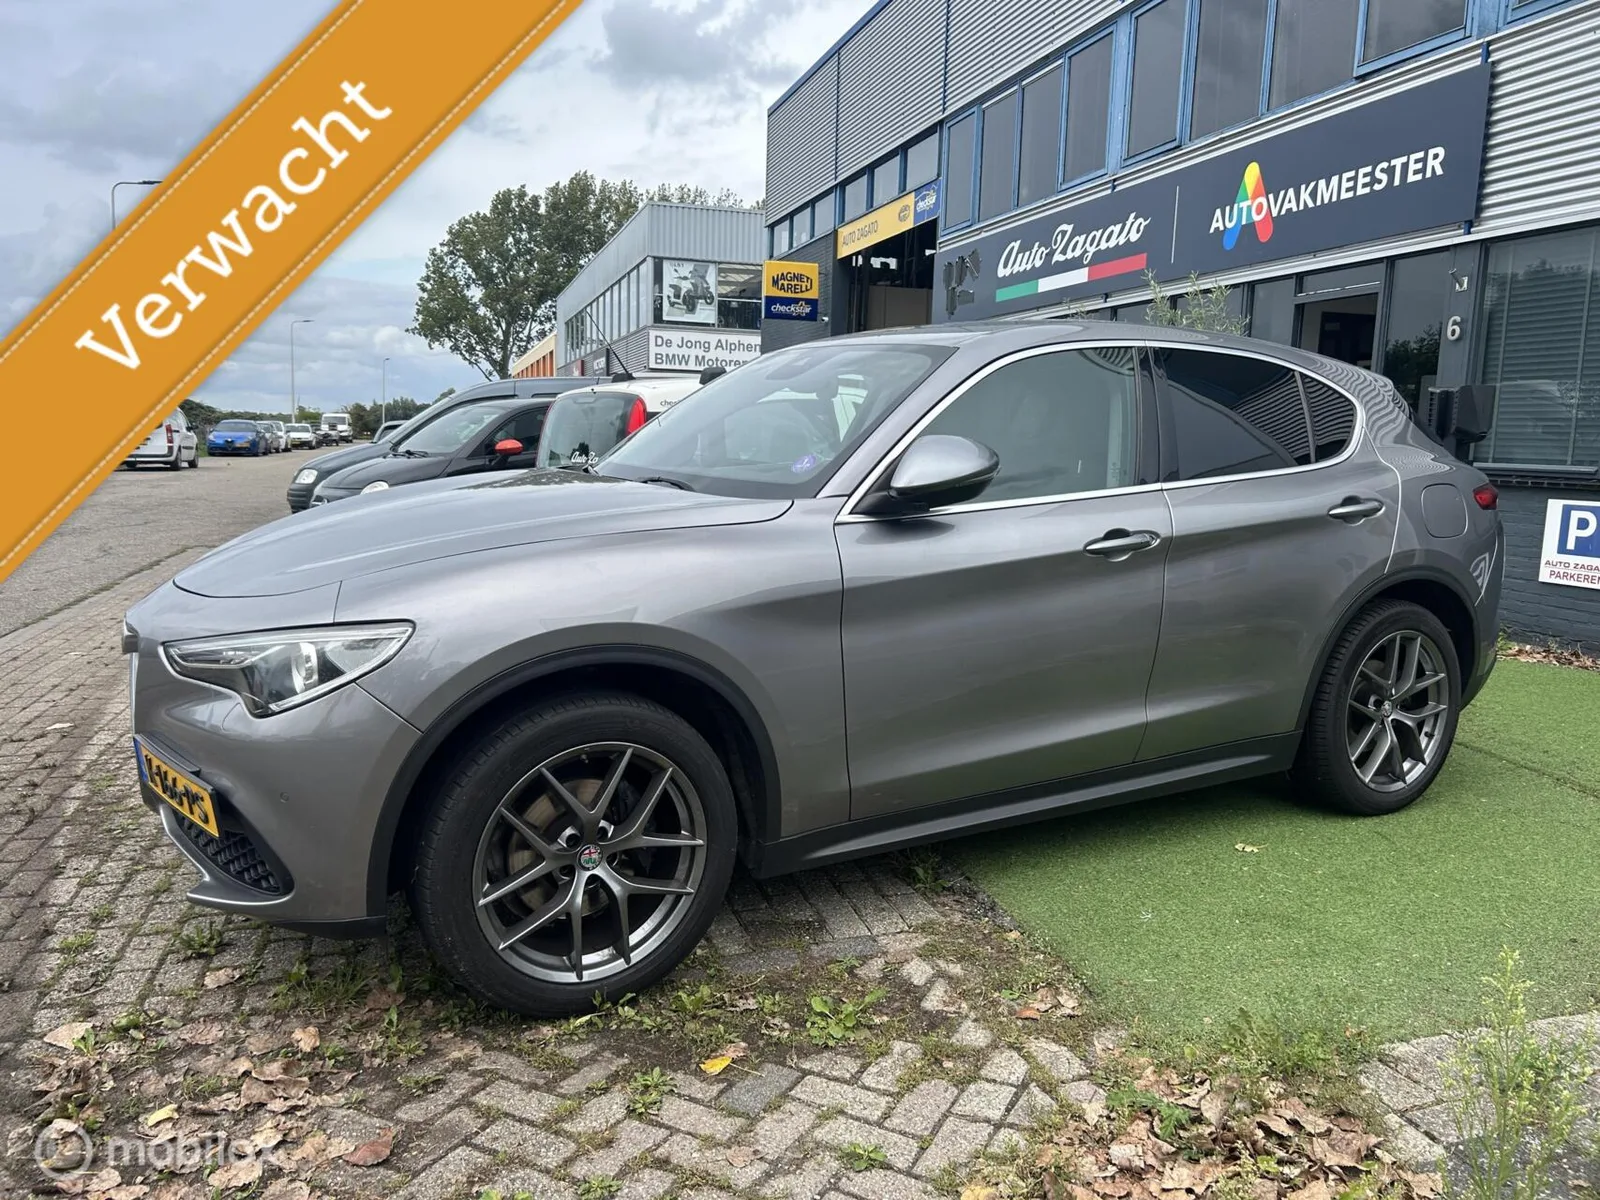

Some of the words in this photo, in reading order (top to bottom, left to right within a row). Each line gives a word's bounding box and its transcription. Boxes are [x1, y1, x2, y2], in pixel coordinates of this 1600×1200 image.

[1209, 146, 1446, 234] AUTOVAKMEESTER
[842, 230, 857, 247] AUTO
[857, 220, 879, 241] ZAGATO
[997, 239, 1050, 278] Auto
[1051, 211, 1151, 266] Zagato
[771, 302, 812, 315] checkstar
[1446, 315, 1462, 342] 6
[654, 335, 673, 348] De
[676, 336, 711, 353] Jong
[714, 339, 761, 354] Alphen
[654, 352, 691, 367] BMW
[1566, 510, 1597, 550] P
[1544, 559, 1571, 569] AUTO
